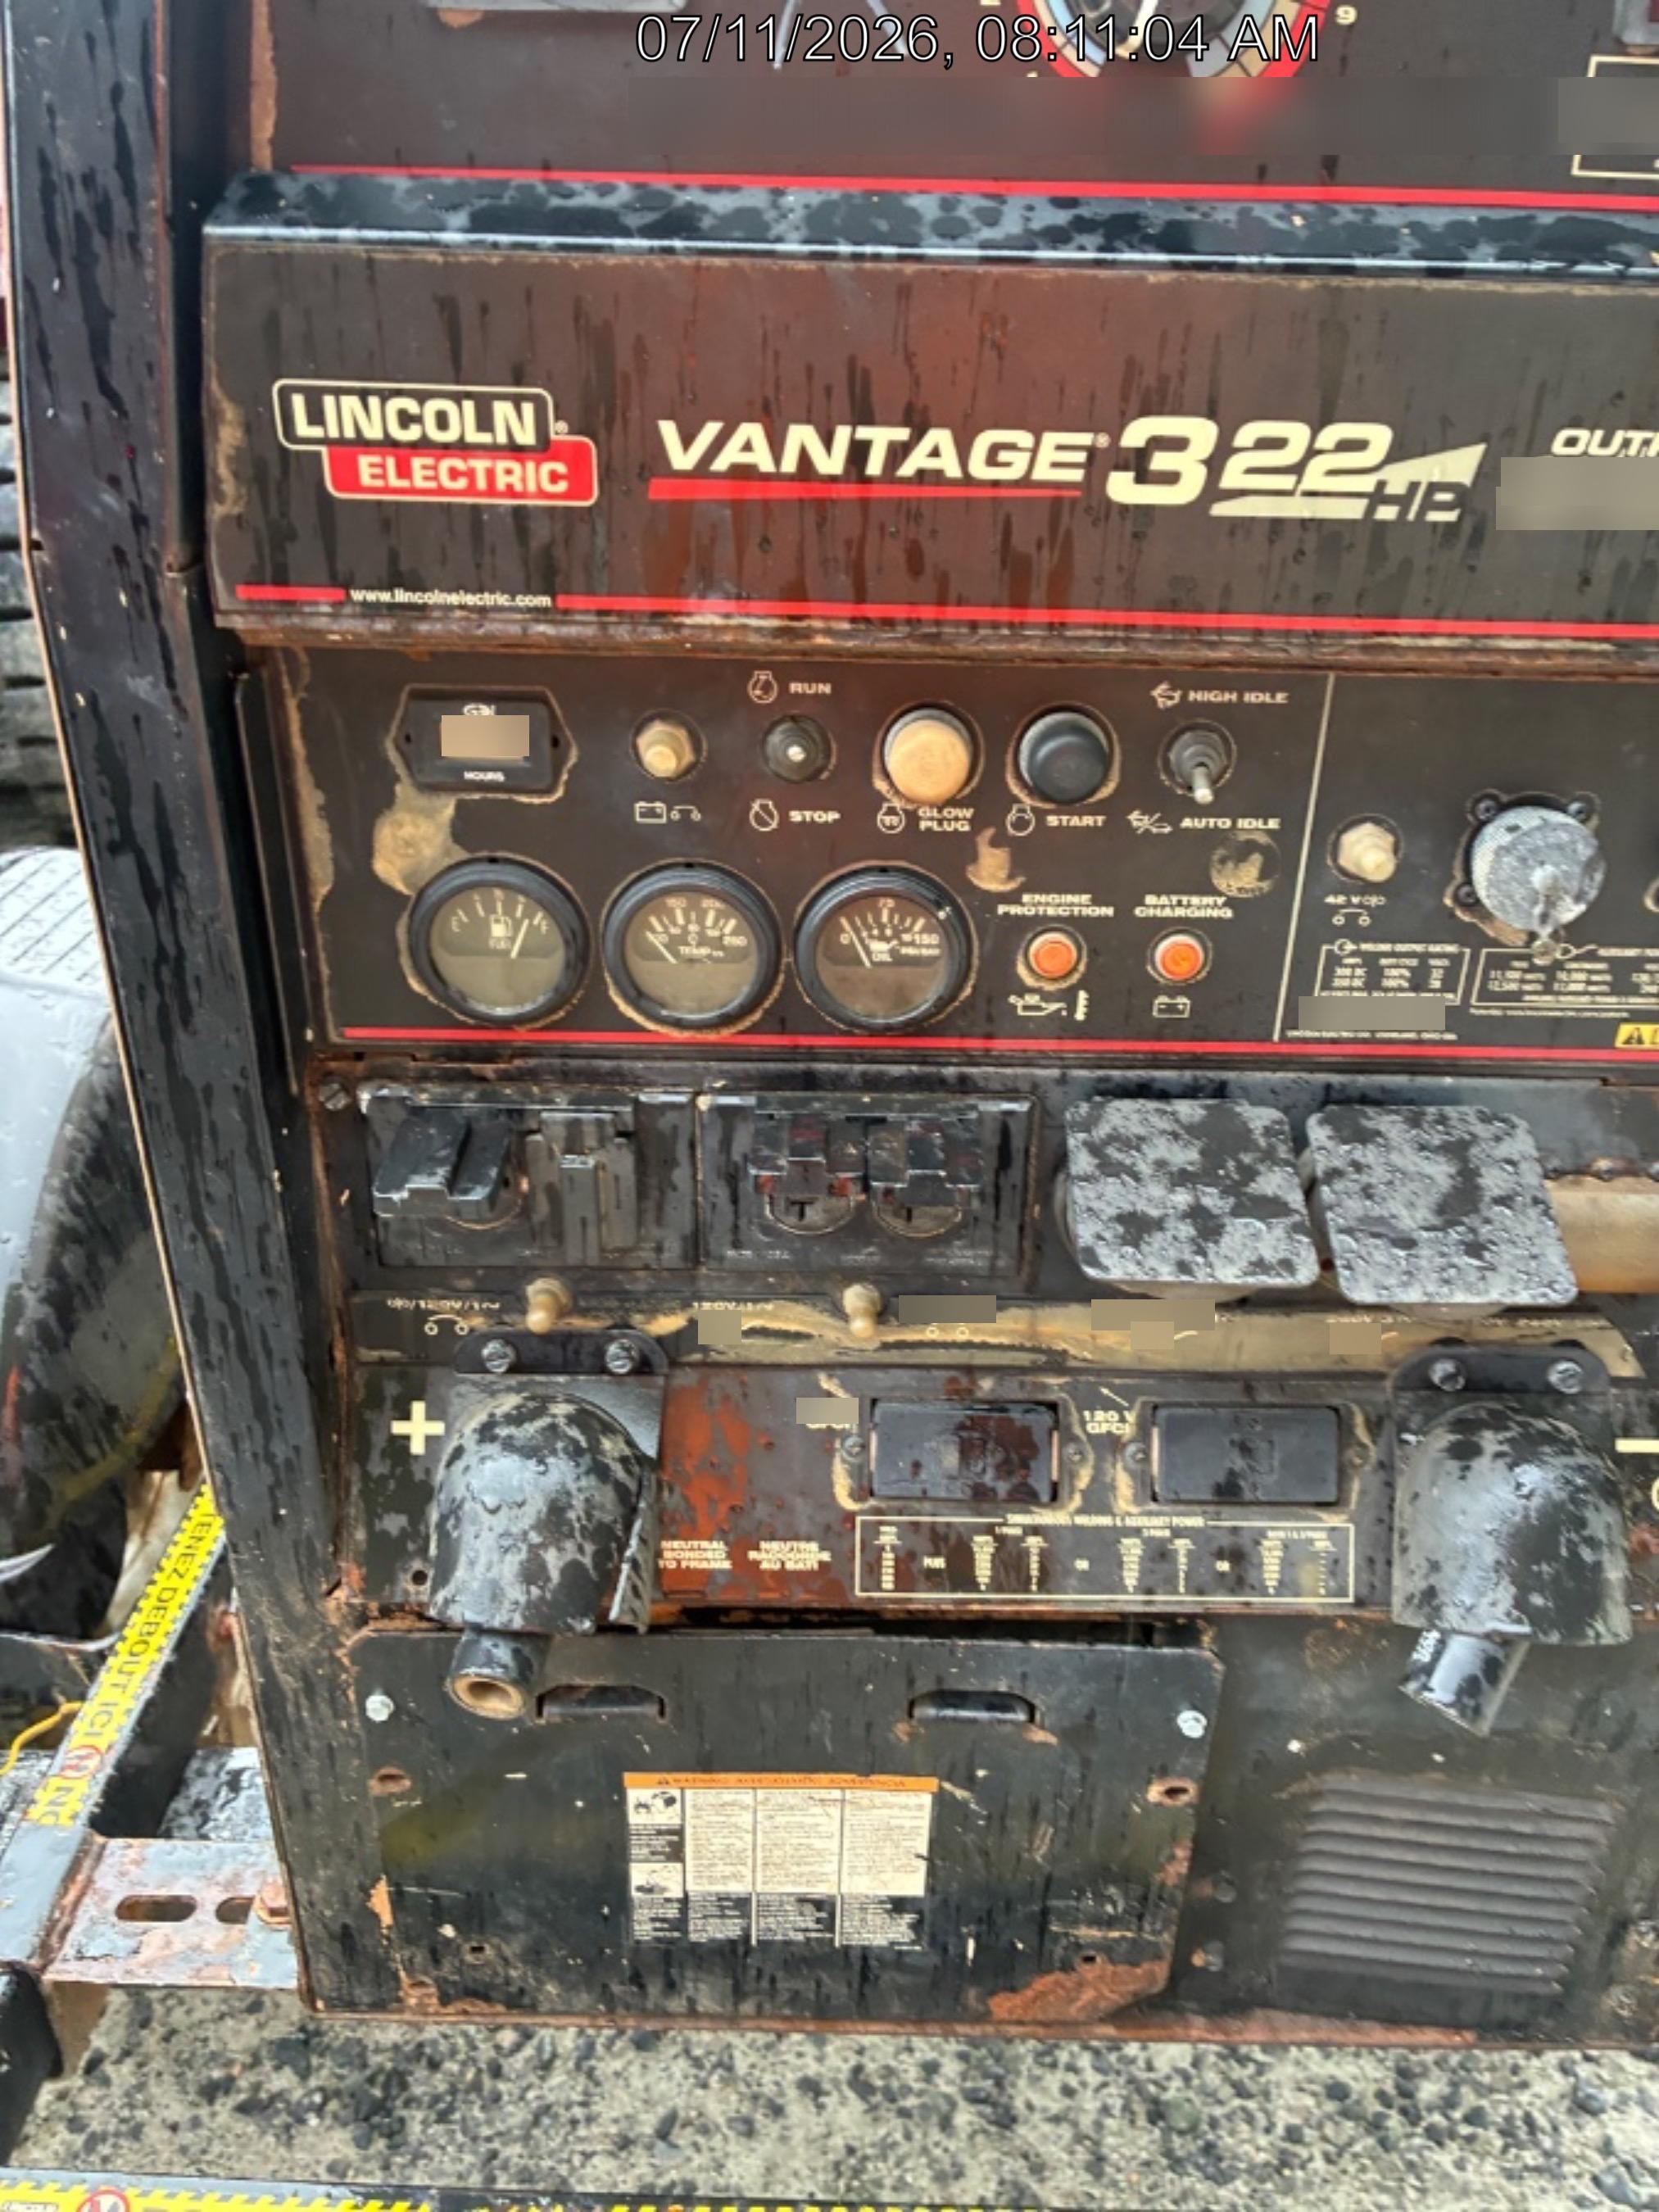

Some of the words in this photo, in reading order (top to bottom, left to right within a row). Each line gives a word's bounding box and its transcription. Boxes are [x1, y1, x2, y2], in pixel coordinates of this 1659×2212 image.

[290, 392, 537, 446] LINCOLN
[1551, 428, 1659, 457] OUT
[1105, 415, 1394, 506] 322
[356, 454, 569, 493] ELECTRIC
[349, 587, 552, 609] www.lincolnelectric.com
[788, 682, 832, 695] RUN
[1187, 690, 1238, 703] HIGH
[1242, 691, 1290, 705] IDLE
[788, 809, 841, 823] STOP
[917, 806, 975, 818] GLOW
[918, 819, 972, 832] PLUG
[1045, 814, 1108, 827] START
[1180, 816, 1231, 830] AUTO
[1235, 817, 1281, 830] IDLE
[1021, 893, 1093, 905] ENGINE
[1144, 894, 1228, 906] BATTERY
[996, 904, 1115, 918] PROTECTION
[1134, 906, 1235, 919] CHARGING
[1086, 1421, 1131, 1435] GFCI
[660, 1540, 728, 1551] NEUTRAL
[663, 1550, 727, 1559] BONDED
[681, 1560, 732, 1570] FRAME
[109, 1587, 179, 1694] DEBOUT
[84, 1702, 120, 1737] ICI
